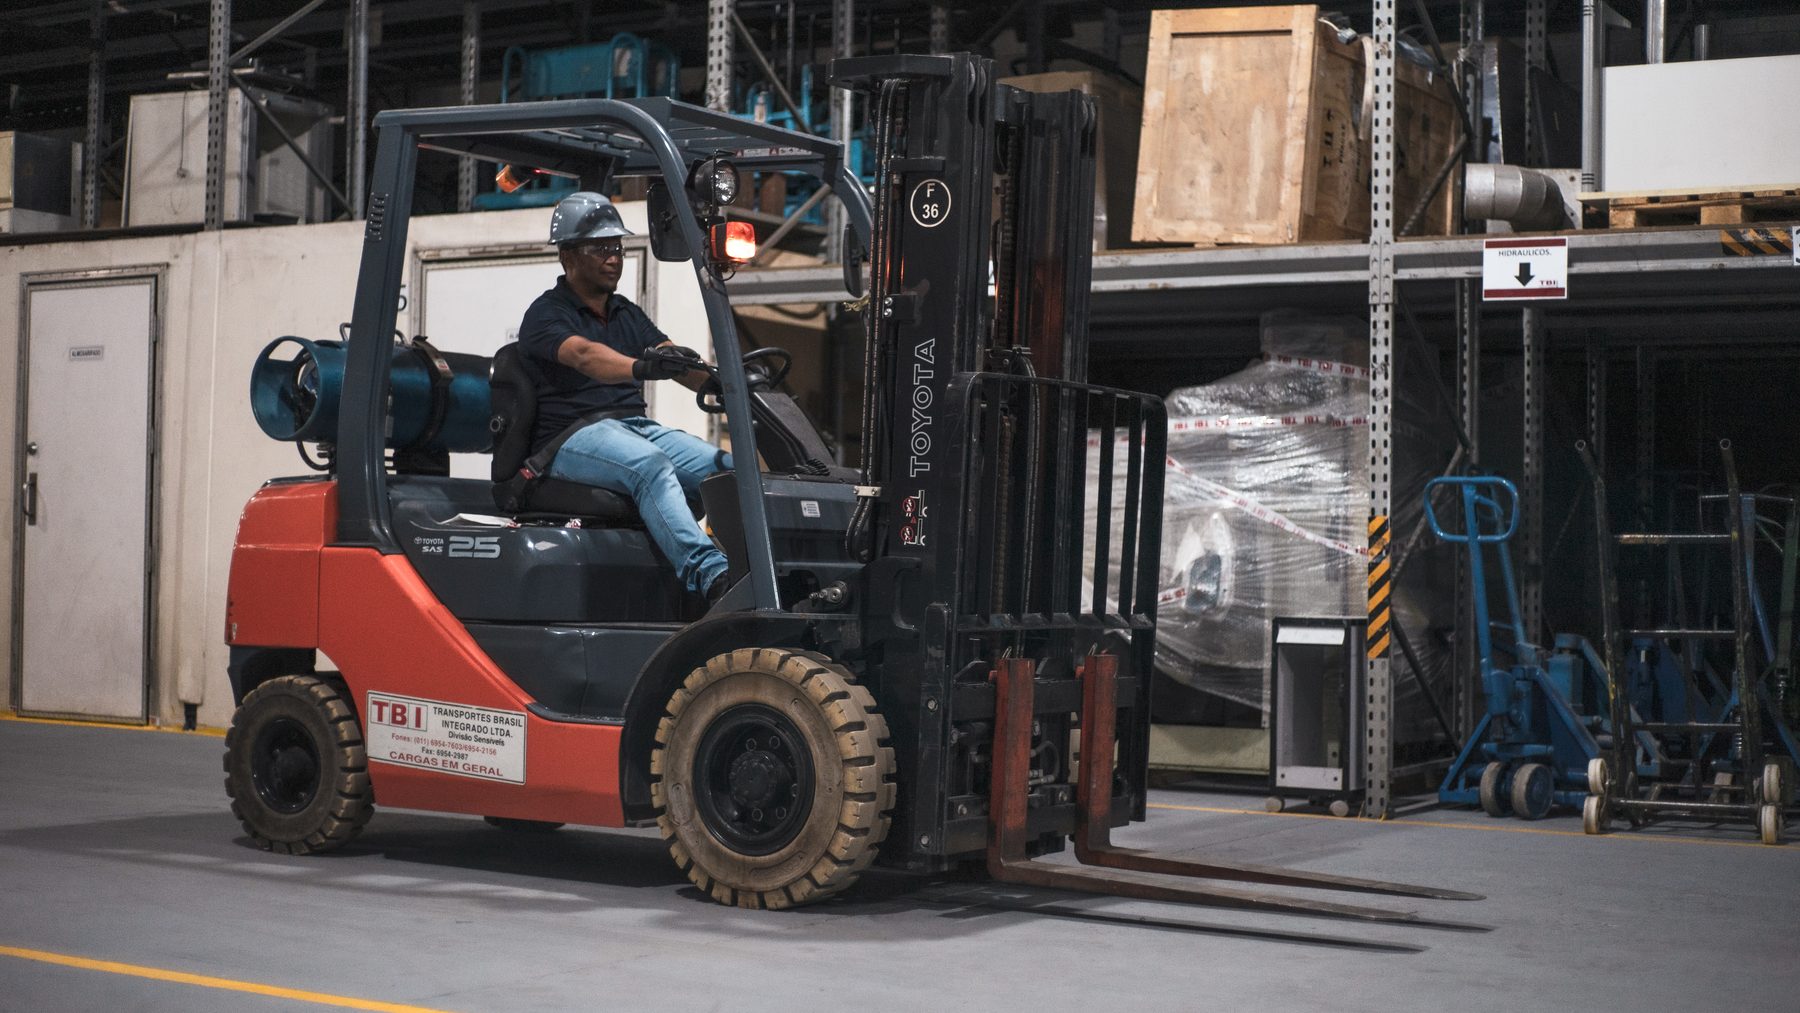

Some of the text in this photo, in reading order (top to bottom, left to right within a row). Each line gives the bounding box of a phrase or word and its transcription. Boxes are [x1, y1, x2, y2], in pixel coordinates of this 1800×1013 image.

[926, 182, 936, 198] F
[922, 203, 939, 219] 36
[910, 338, 936, 478] TOYOTA
[448, 535, 501, 559] 25
[372, 700, 422, 729] TBI
[433, 706, 523, 728] TRANSPORTES BRASIL
[441, 719, 514, 738] INTEGRADO LTDA.
[421, 746, 435, 756] Fax:
[389, 751, 504, 777] CARGAS EM GERAL
